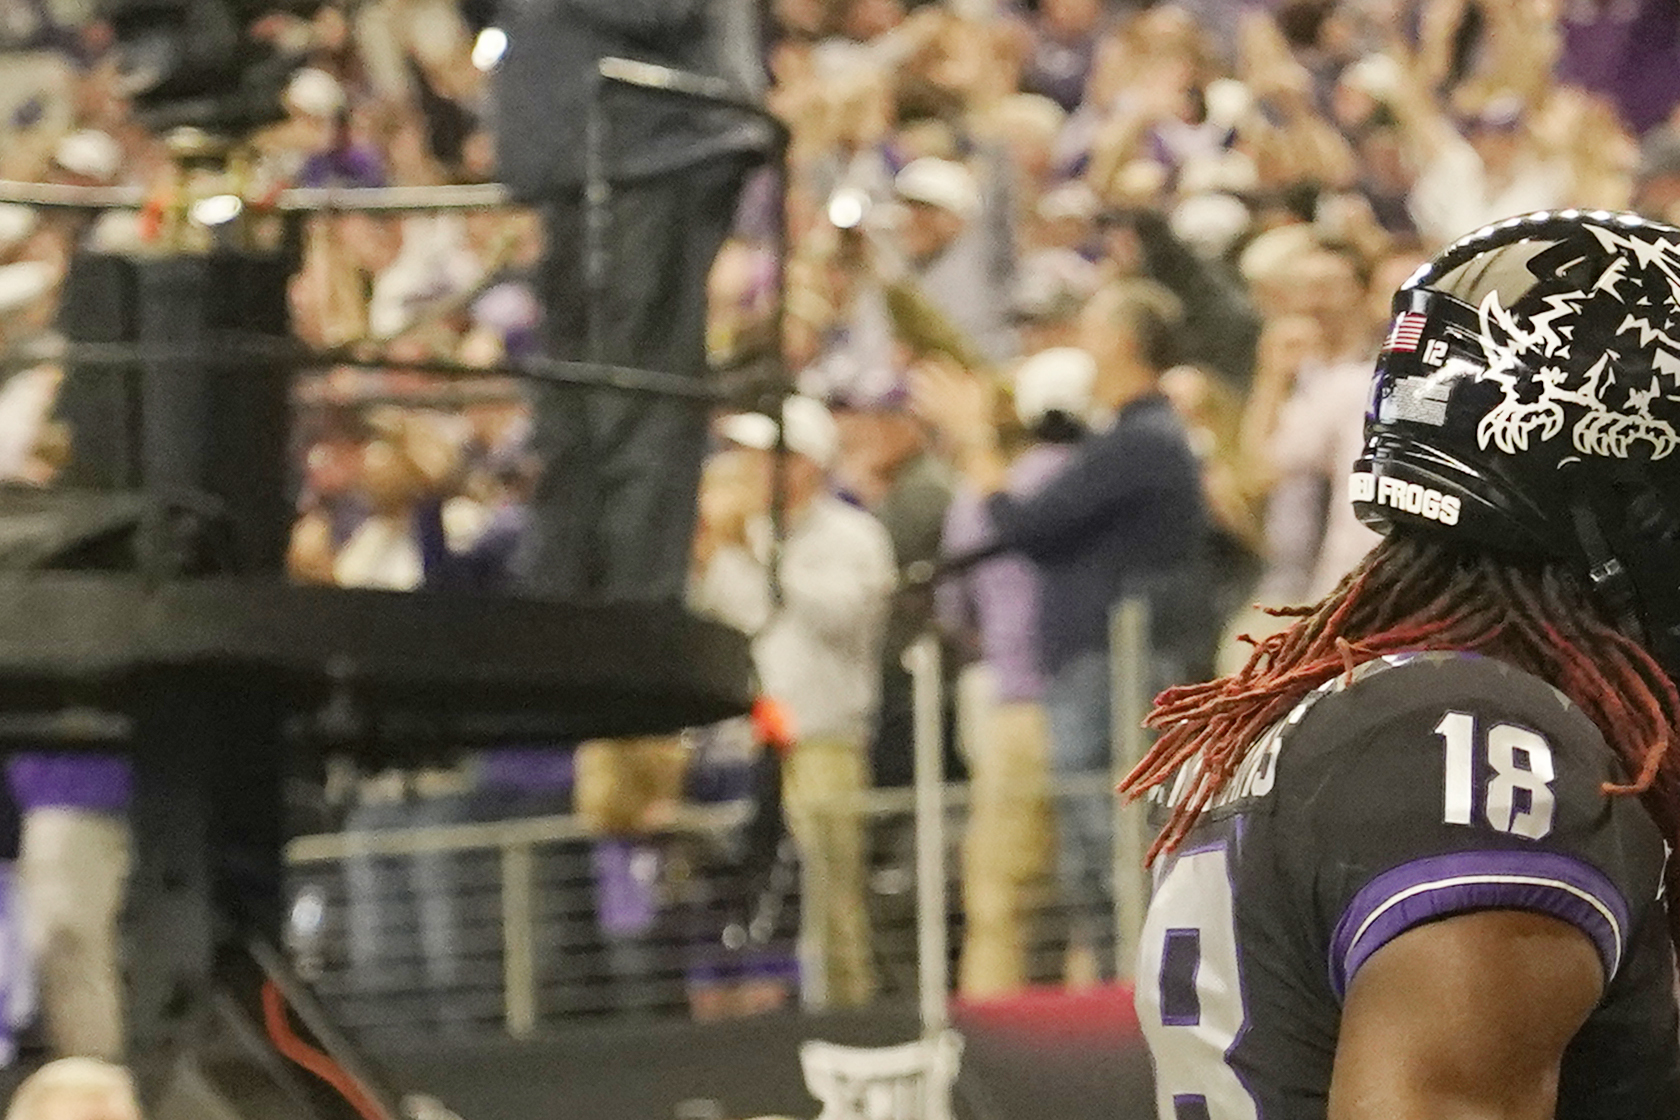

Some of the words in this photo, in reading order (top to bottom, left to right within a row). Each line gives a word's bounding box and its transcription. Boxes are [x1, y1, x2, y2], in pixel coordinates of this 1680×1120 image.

[1422, 338, 1449, 367] 12
[1377, 475, 1461, 526] FROGS
[1433, 710, 1556, 841] 18
